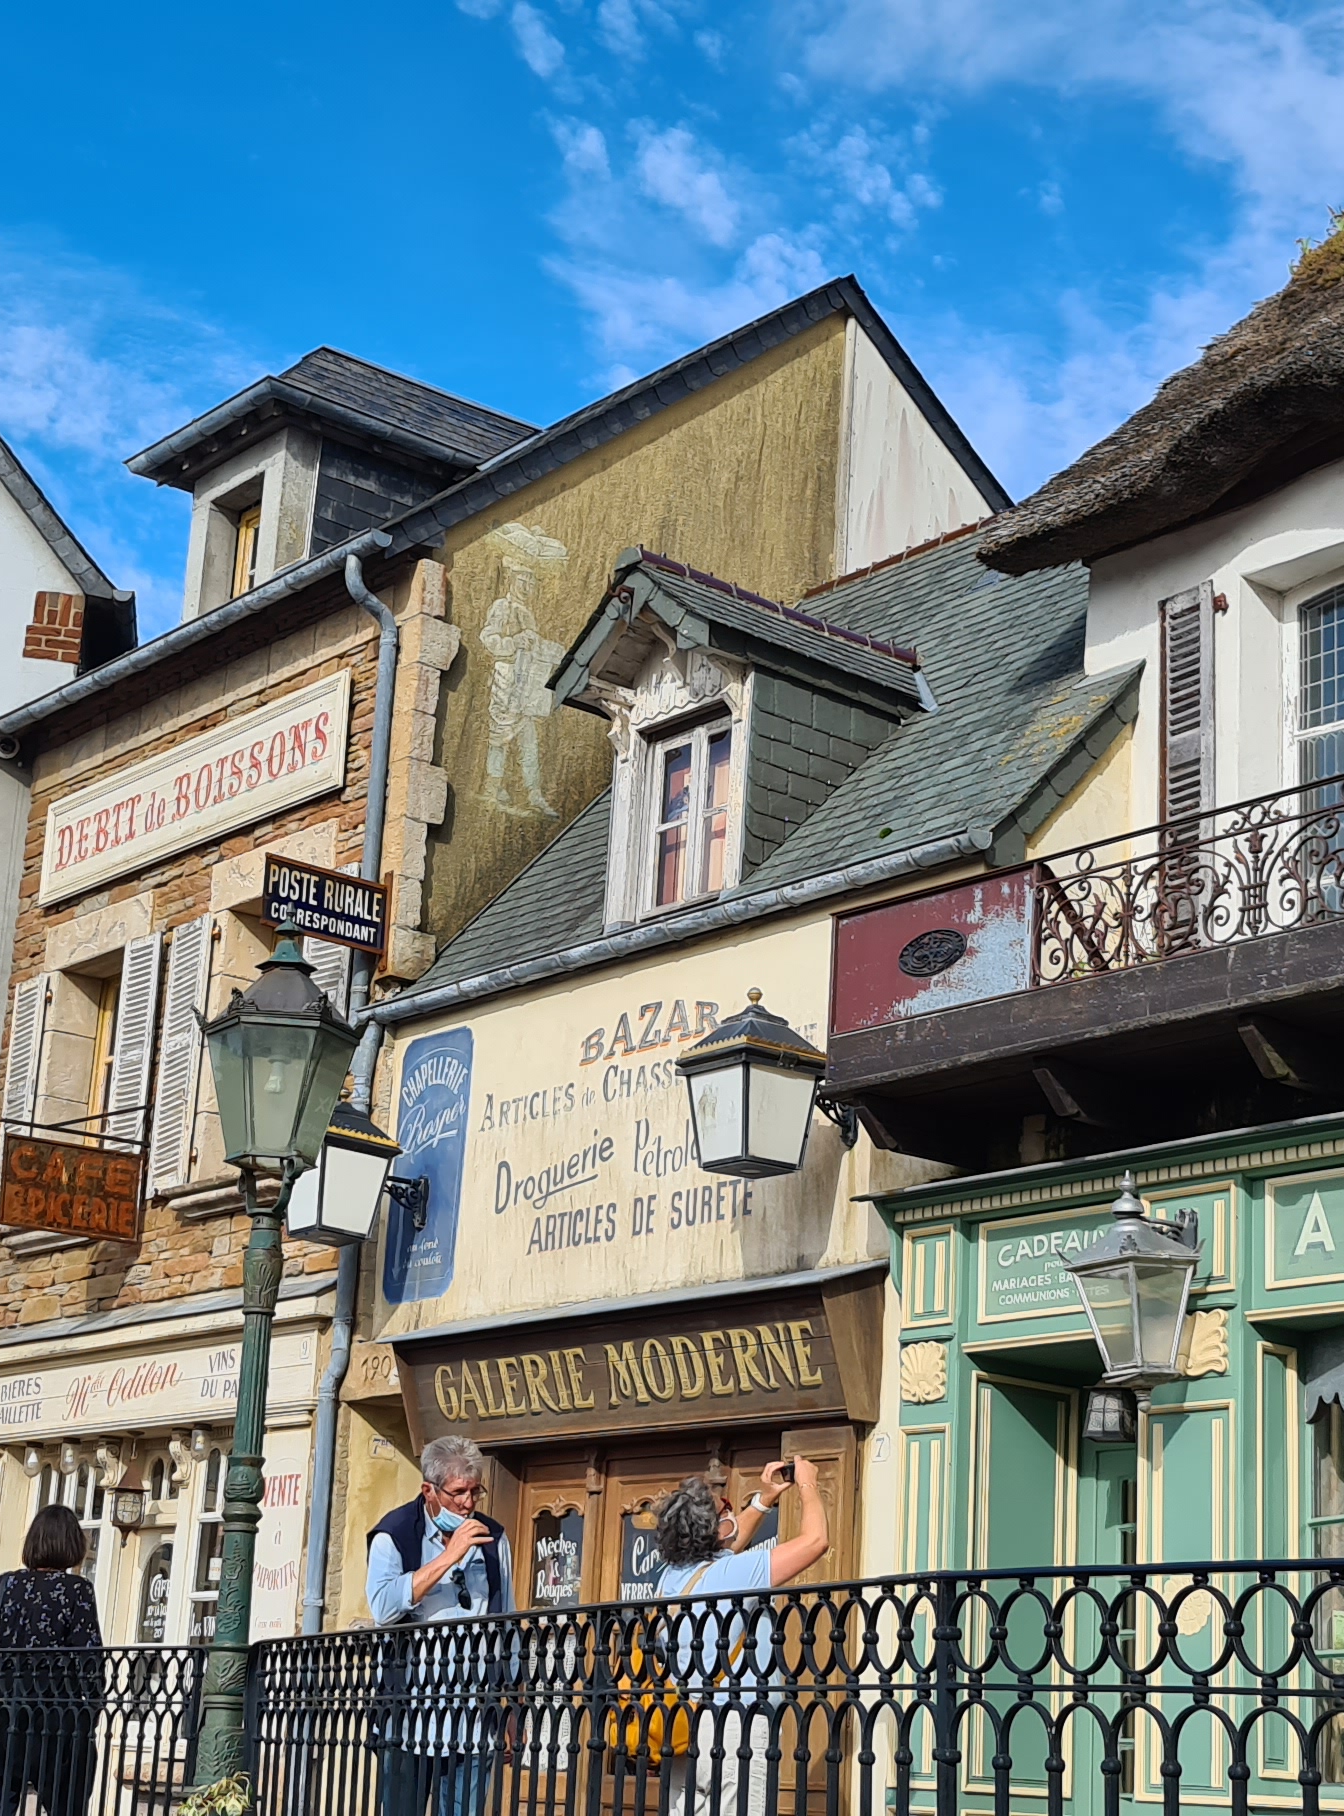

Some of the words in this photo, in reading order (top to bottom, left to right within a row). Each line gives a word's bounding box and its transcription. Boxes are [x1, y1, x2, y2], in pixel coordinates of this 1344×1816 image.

[56, 790, 142, 870] DEBIT
[144, 791, 166, 832] de
[171, 711, 331, 820] BOISSONS
[268, 864, 319, 905] POSTE
[324, 880, 382, 922] RURALE
[271, 902, 376, 943] CORESPONDANT
[579, 999, 719, 1067] BAZAR
[402, 1055, 469, 1107] CHAPELLERIE
[480, 1083, 575, 1133] ARTICLES
[494, 1131, 614, 1214] Droguerie
[526, 1202, 617, 1256] ARTICLES
[632, 1193, 656, 1236] DE
[1294, 1190, 1334, 1256] A
[998, 1229, 1105, 1267] CADEAU
[991, 1273, 1052, 1292] MARIAGES
[1044, 1260, 1063, 1272] pou
[999, 1287, 1070, 1305] COMMUNIONS
[208, 1348, 236, 1373] VINS
[302, 1341, 308, 1355] 9
[434, 1347, 595, 1420] GALERIE
[602, 1320, 822, 1407] MODERNE
[1, 1376, 42, 1402] BIERES
[201, 1378, 218, 1398] DU
[875, 1437, 885, 1458] 7
[263, 1473, 302, 1507] VENTE
[537, 1532, 577, 1562] Mèches
[254, 1560, 297, 1591] MPORTER
[621, 1582, 654, 1600] VERRES
